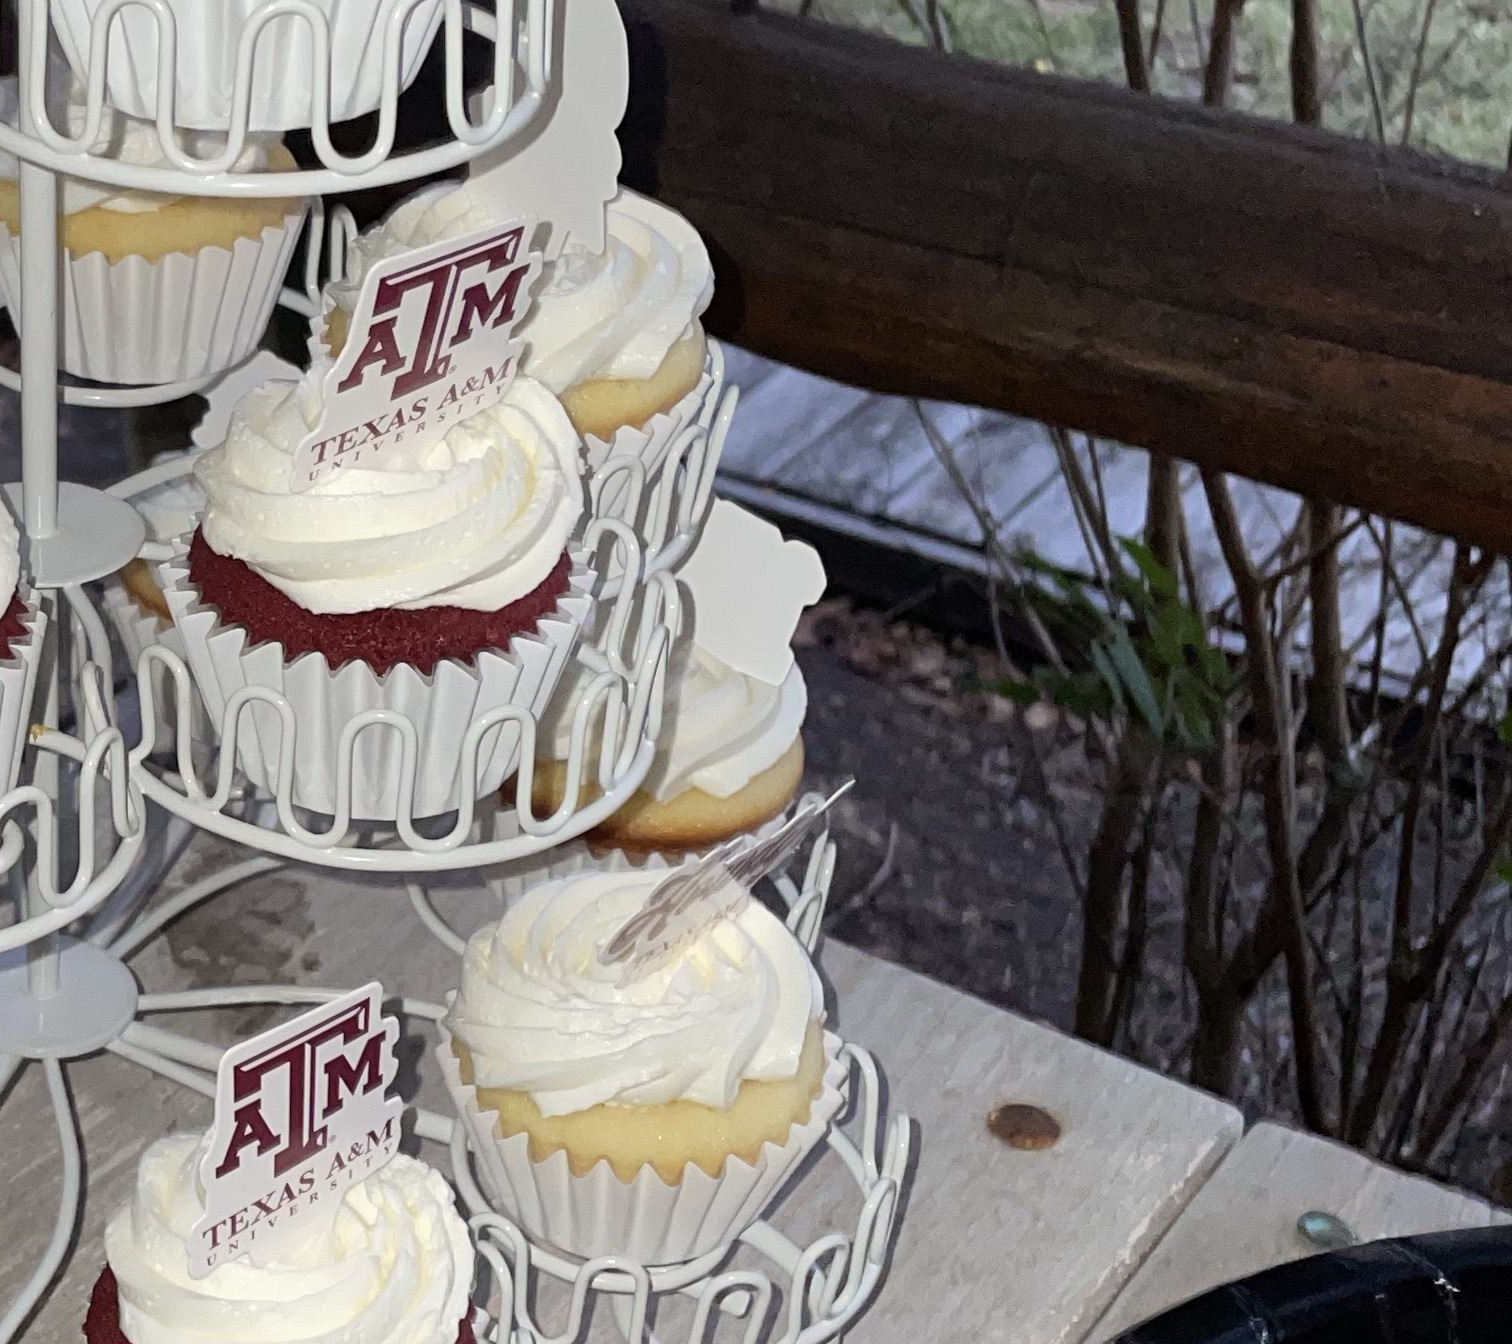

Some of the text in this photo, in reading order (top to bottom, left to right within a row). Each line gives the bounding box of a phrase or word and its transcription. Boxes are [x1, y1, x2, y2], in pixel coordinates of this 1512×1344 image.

[308, 382, 505, 482] UNIVERSITY
[310, 356, 515, 466] TEXAS A&M
[203, 1116, 396, 1251] TEXAS A&M
[207, 1143, 392, 1267] UNIVERSITY
